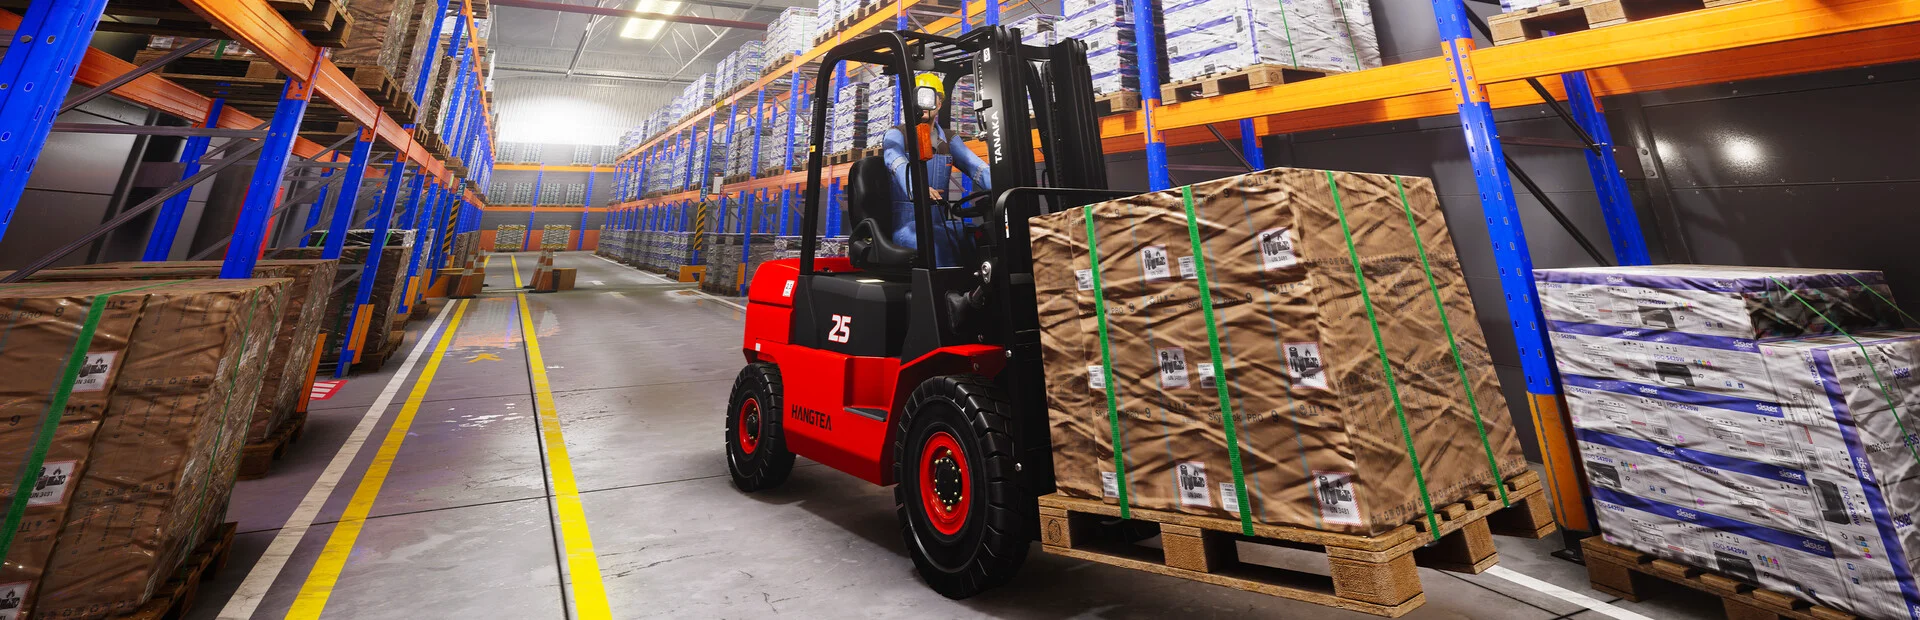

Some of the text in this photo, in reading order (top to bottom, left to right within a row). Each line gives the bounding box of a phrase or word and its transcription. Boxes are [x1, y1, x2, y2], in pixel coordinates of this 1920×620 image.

[991, 110, 1002, 165] TANAKA
[1223, 188, 1230, 198] 9
[1245, 293, 1252, 304] 9
[19, 311, 42, 320] PRO
[55, 306, 65, 318] 9
[1111, 302, 1135, 315] PRO 9
[828, 314, 852, 343] 25
[791, 403, 832, 431] HANGTEA
[1144, 407, 1151, 419] 9
[1247, 413, 1263, 423] PRO
[1271, 410, 1279, 423] 9
[9, 415, 20, 426] 9
[1338, 507, 1350, 515] 3481
